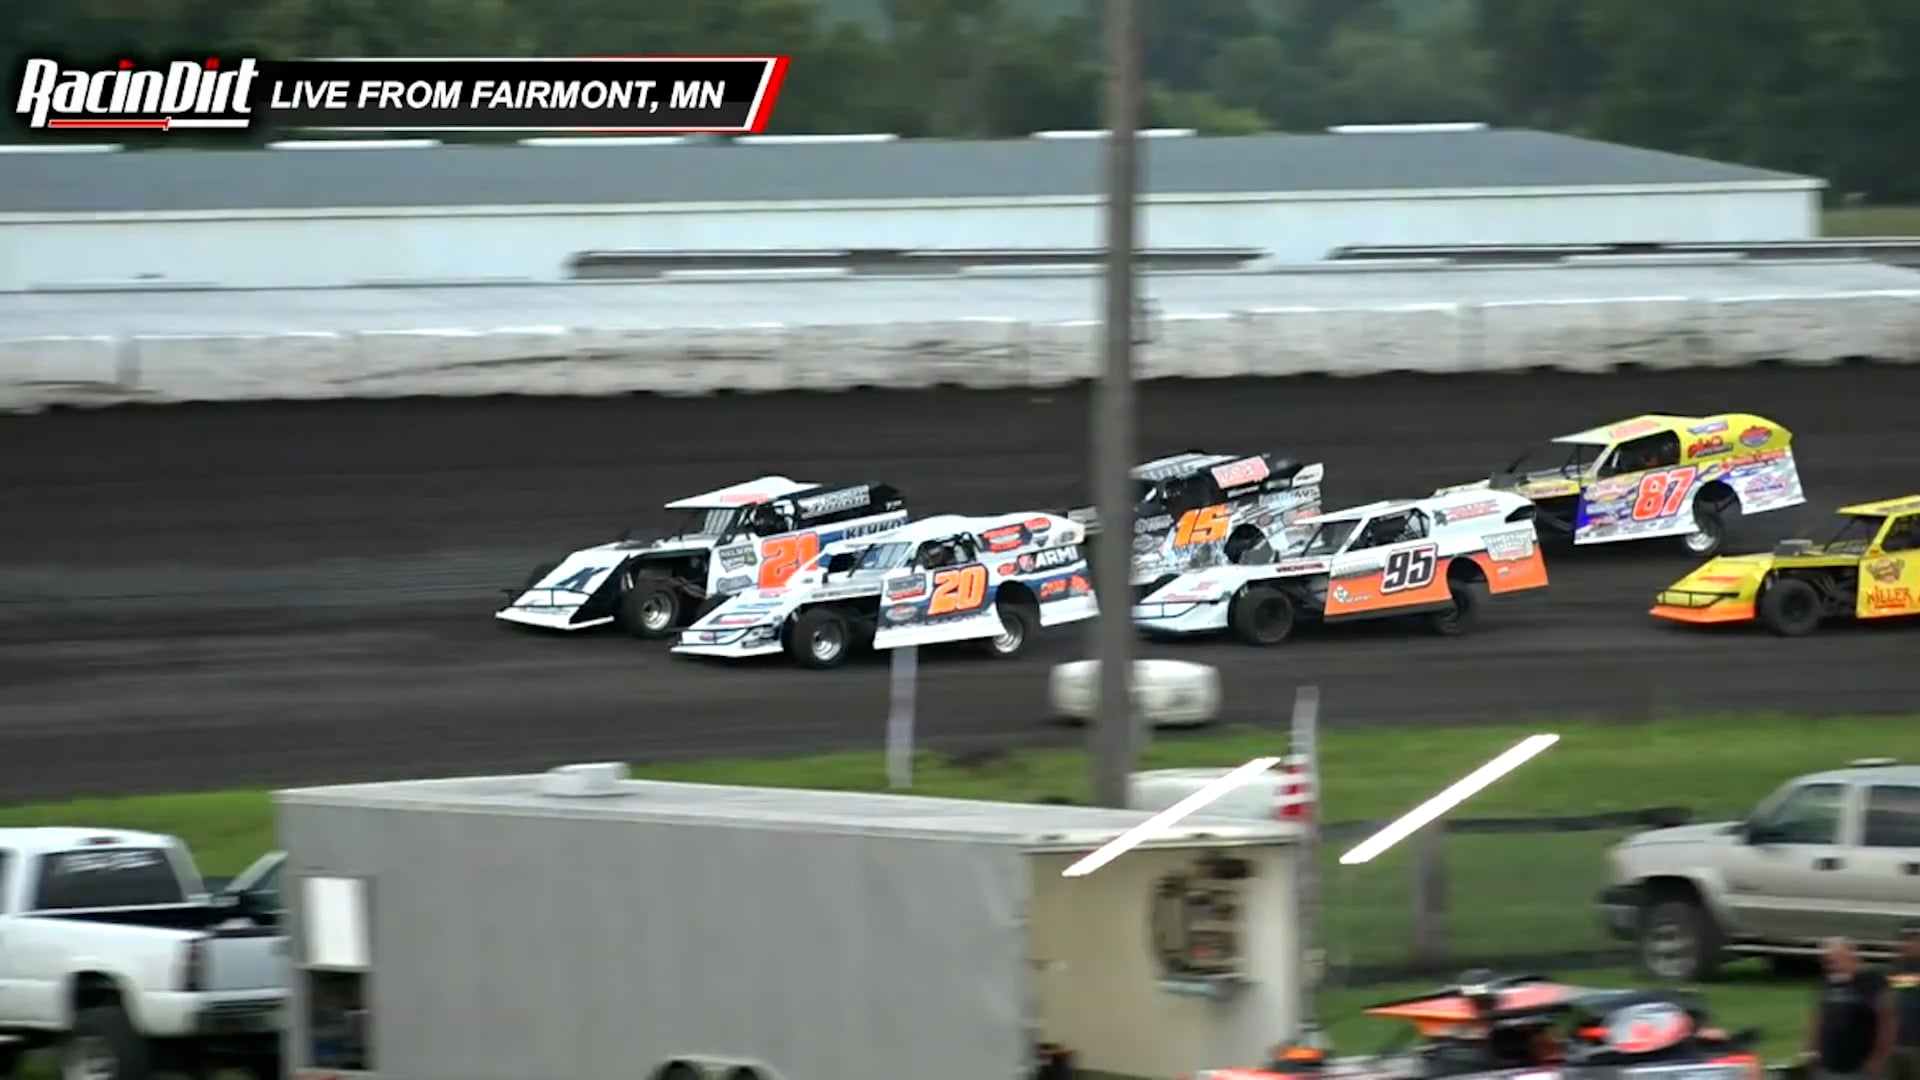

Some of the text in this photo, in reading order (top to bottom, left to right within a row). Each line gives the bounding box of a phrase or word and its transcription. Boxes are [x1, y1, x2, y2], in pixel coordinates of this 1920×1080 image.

[1632, 466, 1698, 521] 87
[1174, 503, 1230, 549] 15
[758, 531, 820, 589] 21
[1382, 543, 1438, 593] 95
[927, 563, 989, 616] 20
